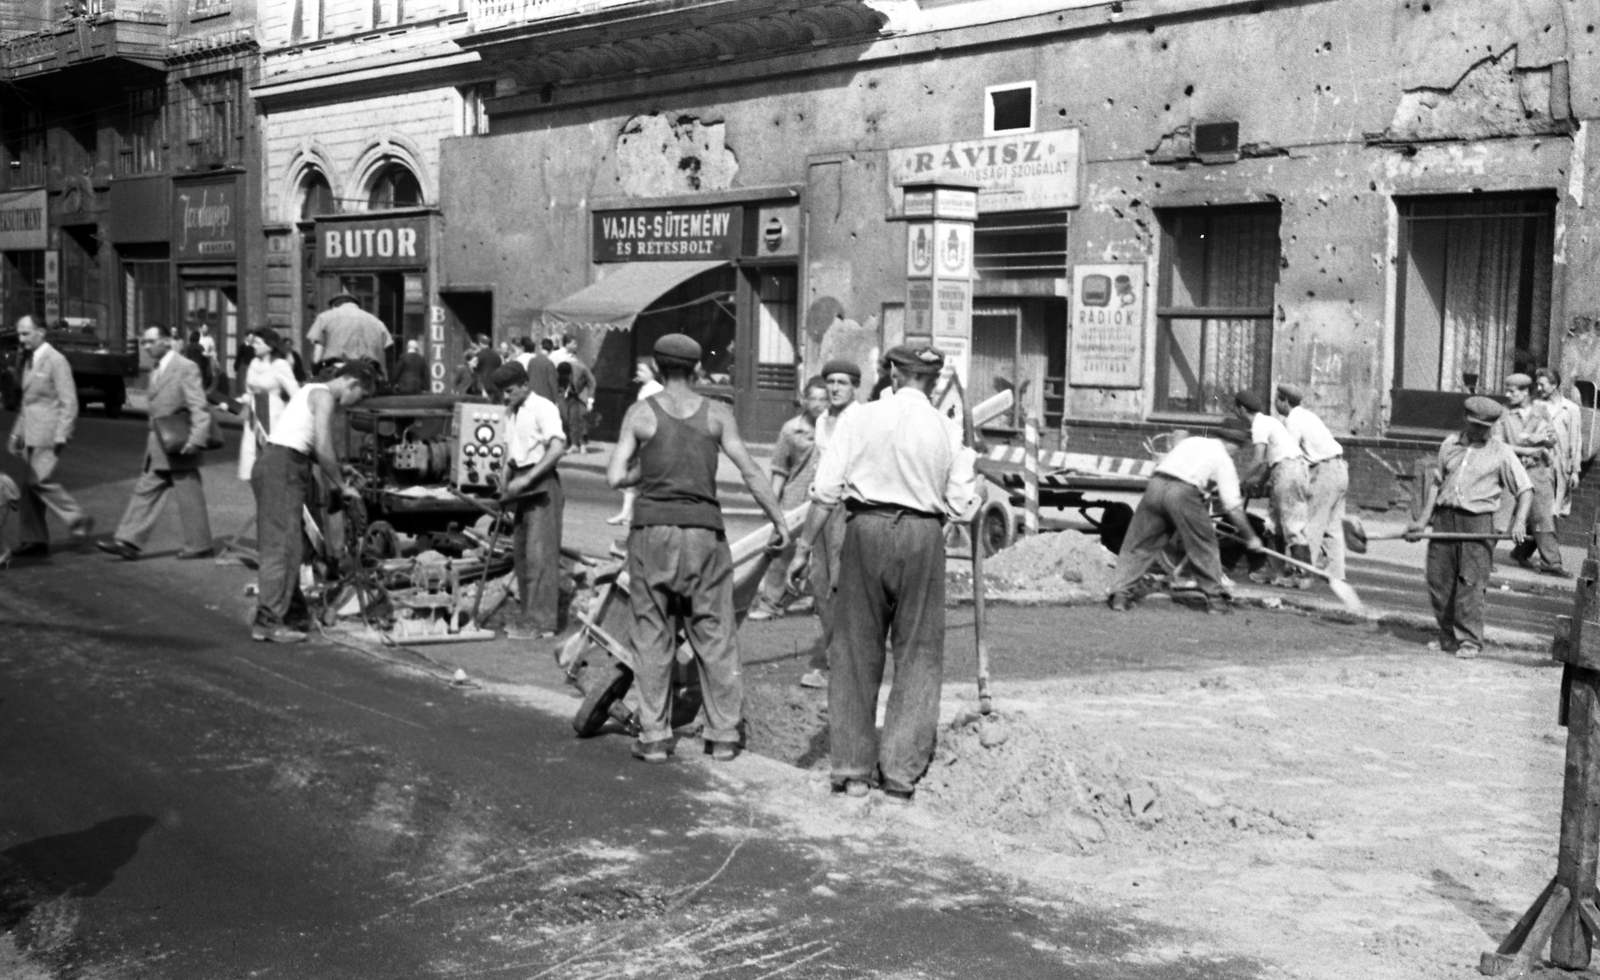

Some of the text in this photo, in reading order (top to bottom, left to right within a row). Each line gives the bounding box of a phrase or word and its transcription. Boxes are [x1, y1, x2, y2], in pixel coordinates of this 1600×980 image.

[603, 210, 730, 239] VAJAS-SÜTEMÉNY
[325, 228, 417, 258] BUTOR
[616, 240, 632, 255] ÉS
